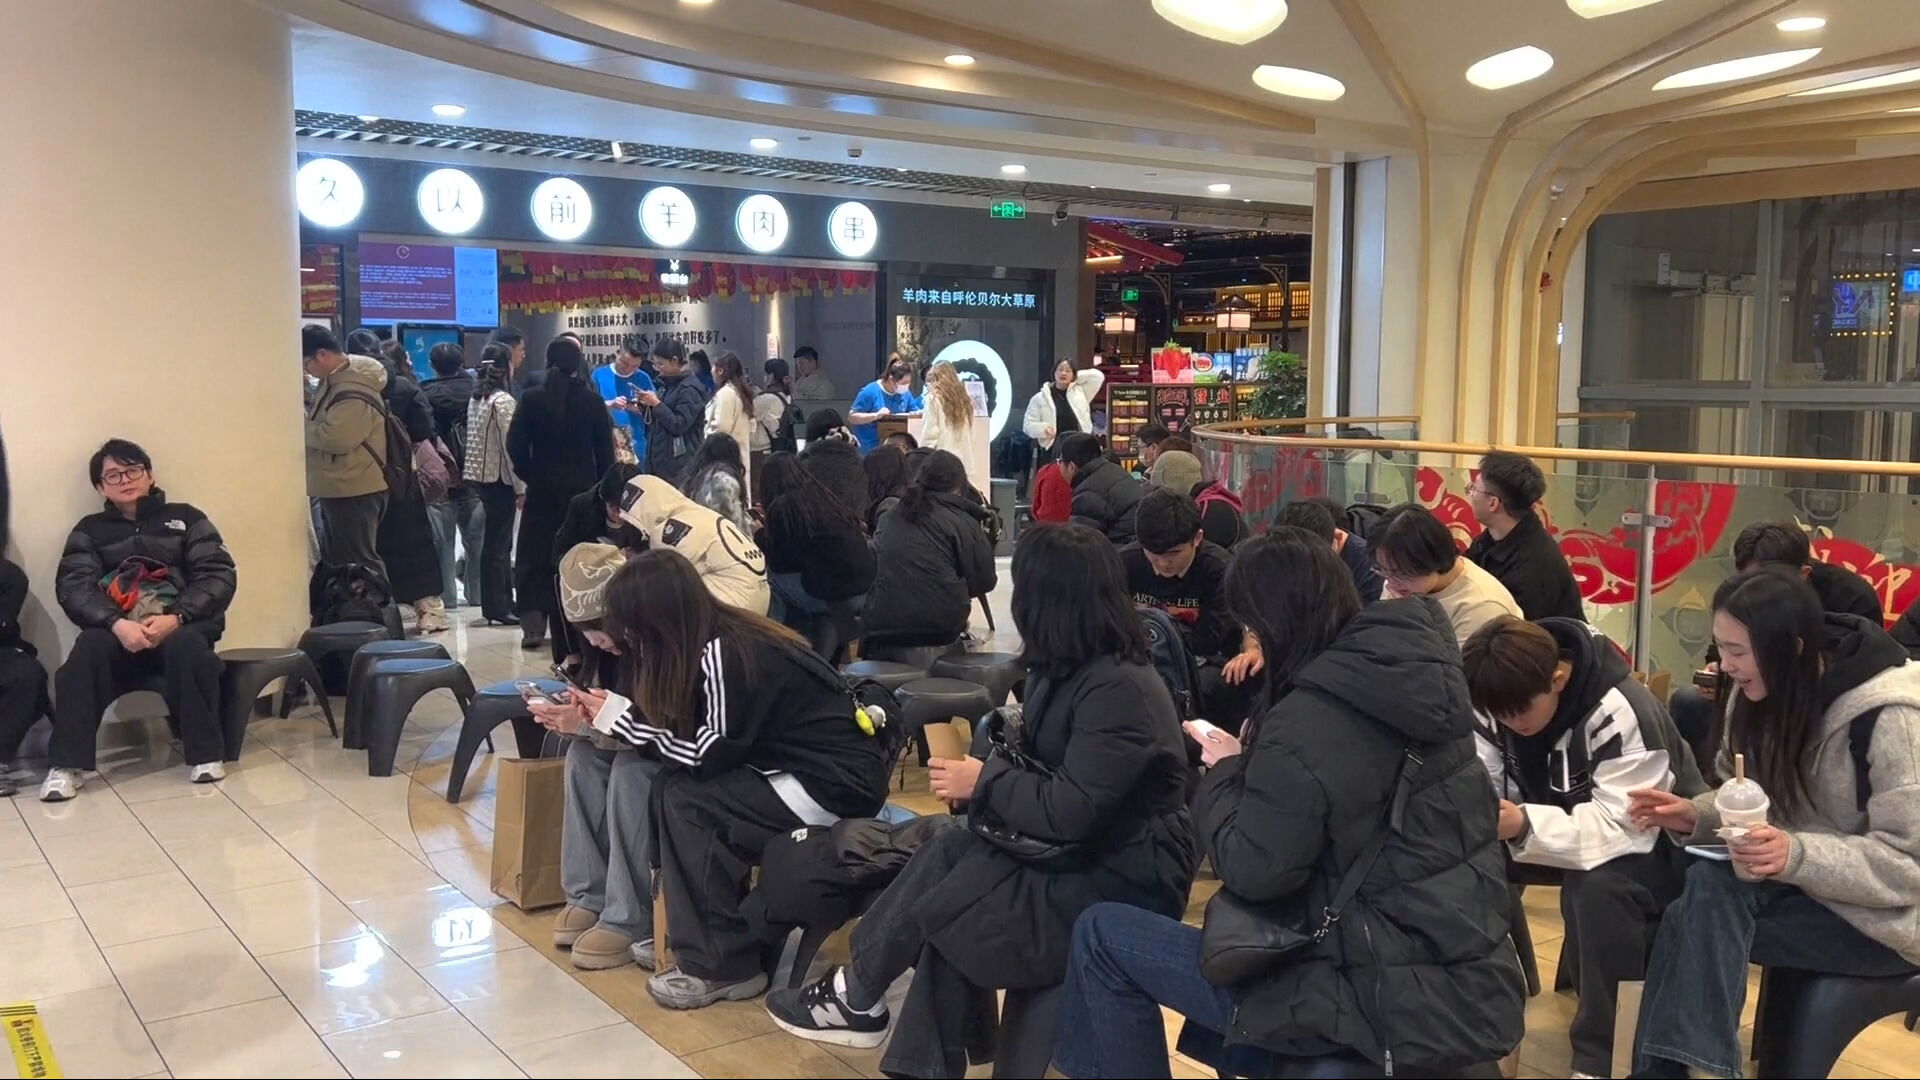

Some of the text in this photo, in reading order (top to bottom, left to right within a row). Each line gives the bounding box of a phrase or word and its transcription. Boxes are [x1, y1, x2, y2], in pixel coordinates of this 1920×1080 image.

[318, 174, 866, 242] 久以前羊肉串
[902, 287, 1036, 309] 羊肉来自呼伦贝尔大草原
[1177, 597, 1200, 608] LIFE
[810, 1002, 849, 1028] N
